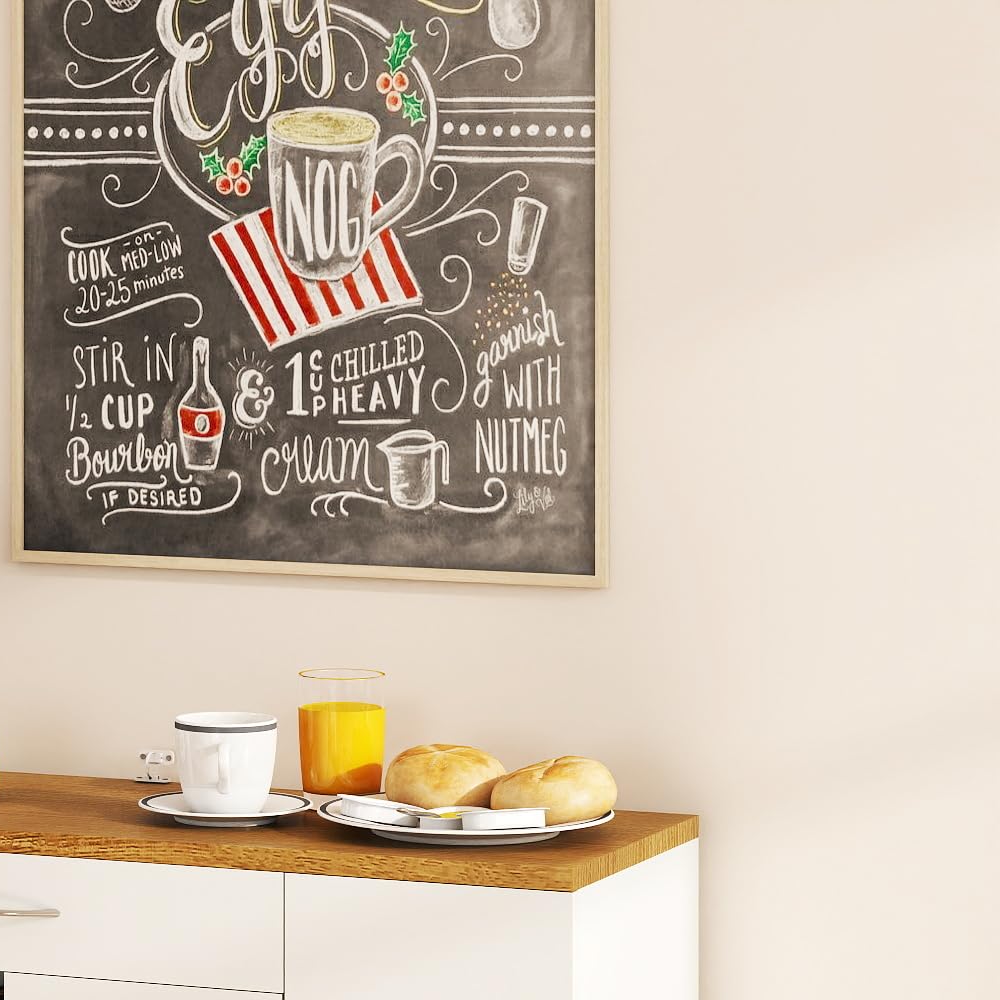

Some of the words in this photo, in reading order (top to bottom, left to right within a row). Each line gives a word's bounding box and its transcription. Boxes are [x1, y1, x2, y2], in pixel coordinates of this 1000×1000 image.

[285, 156, 360, 262] NOG
[68, 246, 117, 284] COOK
[121, 234, 182, 272] MED-LOW
[75, 277, 131, 314] 20-25
[133, 265, 184, 294] minutes
[331, 331, 424, 382] CHILLED
[473, 290, 565, 408] garnish
[232, 366, 274, 429] &
[285, 352, 309, 416] 1
[333, 365, 425, 415] HEAVY
[503, 354, 560, 411] WITH
[101, 393, 154, 430] CUP
[66, 433, 192, 485] Bourbon
[475, 416, 567, 476] NUTMEG
[102, 489, 119, 509] IF
[128, 487, 202, 507] DESIRED
